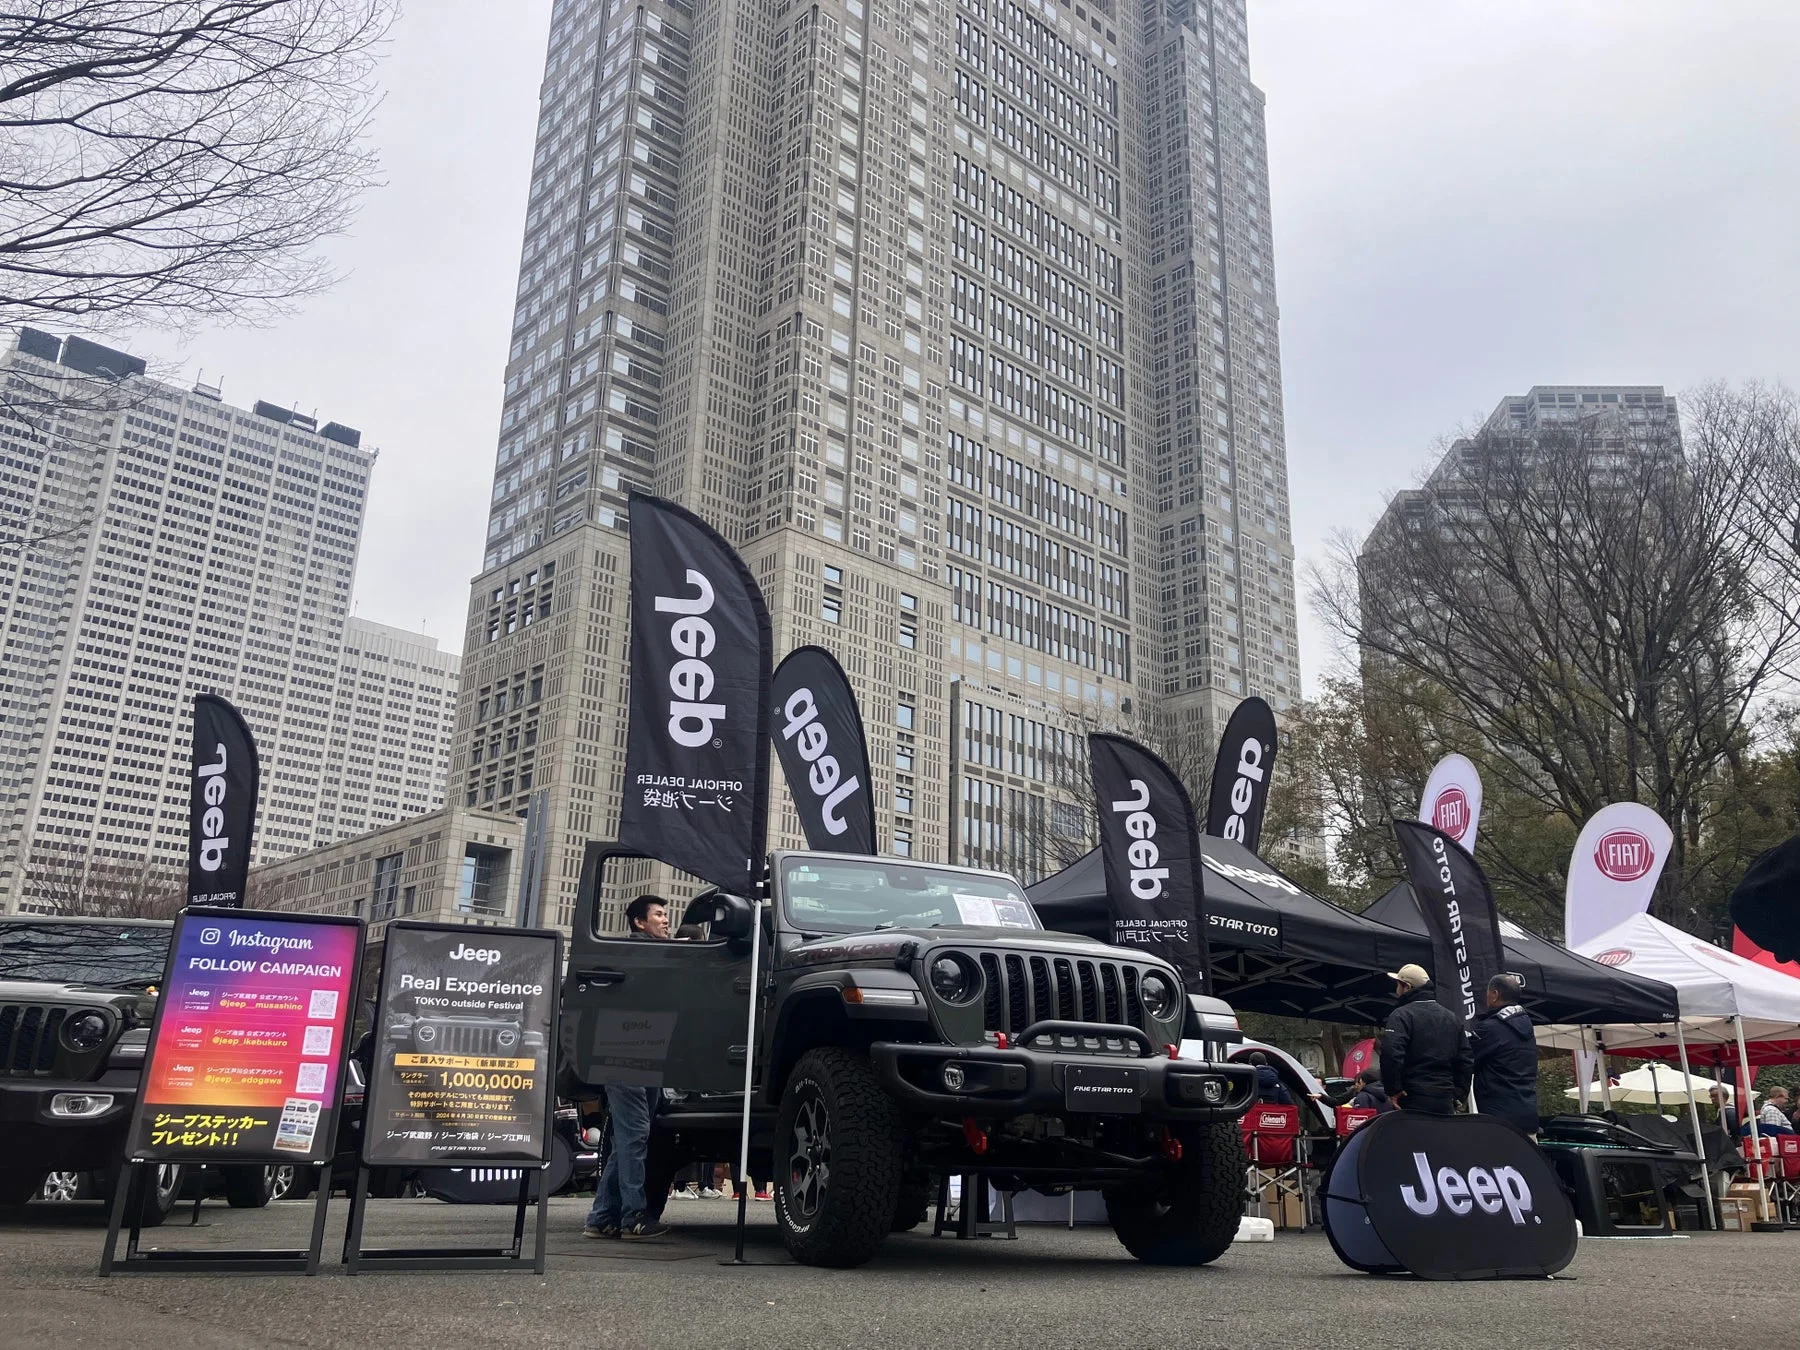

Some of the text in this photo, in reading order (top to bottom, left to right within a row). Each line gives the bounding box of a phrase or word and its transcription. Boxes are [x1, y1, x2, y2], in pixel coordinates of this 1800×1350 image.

[1223, 737, 1265, 843] eep
[1440, 800, 1462, 830] FIAT
[1608, 843, 1640, 867] FIAT
[1209, 915, 1278, 937] STAR TOTO
[228, 929, 314, 955] Instagram
[449, 943, 501, 965] Jeep
[189, 957, 342, 978] FOLLOW CAMPAIGN
[188, 988, 210, 998] Jeep
[400, 974, 543, 996] Real Experience
[414, 996, 524, 1010] TOKYO outside Festival
[181, 1025, 202, 1034] Jeep
[172, 1063, 194, 1072] Jeep
[154, 1113, 269, 1130] ジープステッカー
[1399, 1152, 1532, 1225] Jeep
